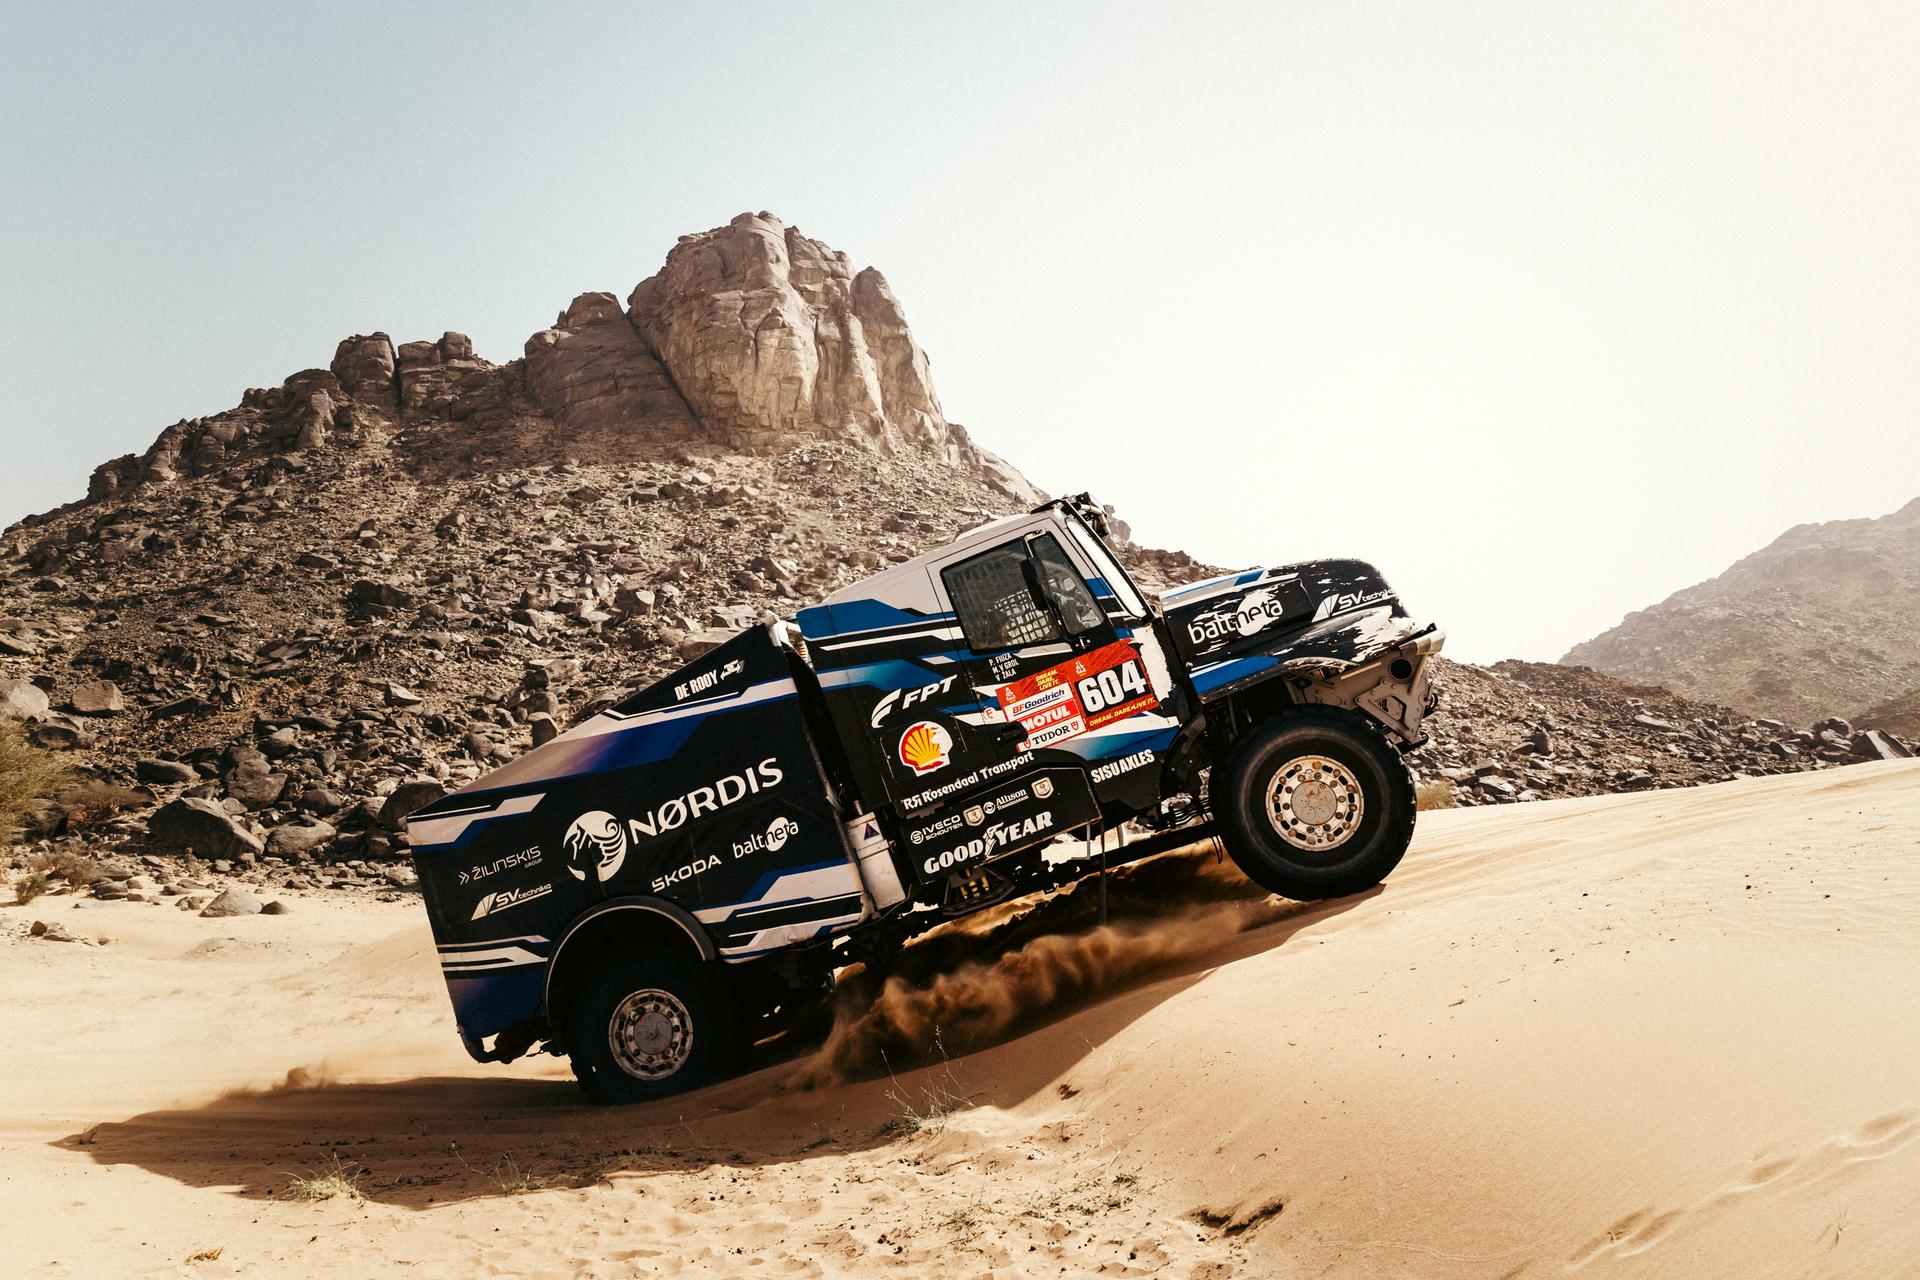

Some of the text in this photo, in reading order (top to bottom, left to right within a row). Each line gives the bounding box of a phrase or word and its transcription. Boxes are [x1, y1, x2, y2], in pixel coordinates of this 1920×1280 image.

[1187, 599, 1284, 644] baltneta
[674, 669, 718, 701] DE ROOY
[1002, 668, 1017, 679] ZALA
[1078, 660, 1147, 712] 604
[902, 674, 958, 709] FPT
[1012, 689, 1065, 714] BFGoodrich
[1021, 705, 1071, 731] MOTUL
[1032, 725, 1071, 745] TUDOR
[921, 771, 979, 803] Rosendaal
[979, 750, 1035, 781] Transport
[627, 757, 784, 846] NØRDIS
[996, 788, 1027, 806] Allison
[922, 814, 961, 835] IVECO
[925, 822, 963, 840] SCHOUTEN
[732, 820, 799, 859] baltneta
